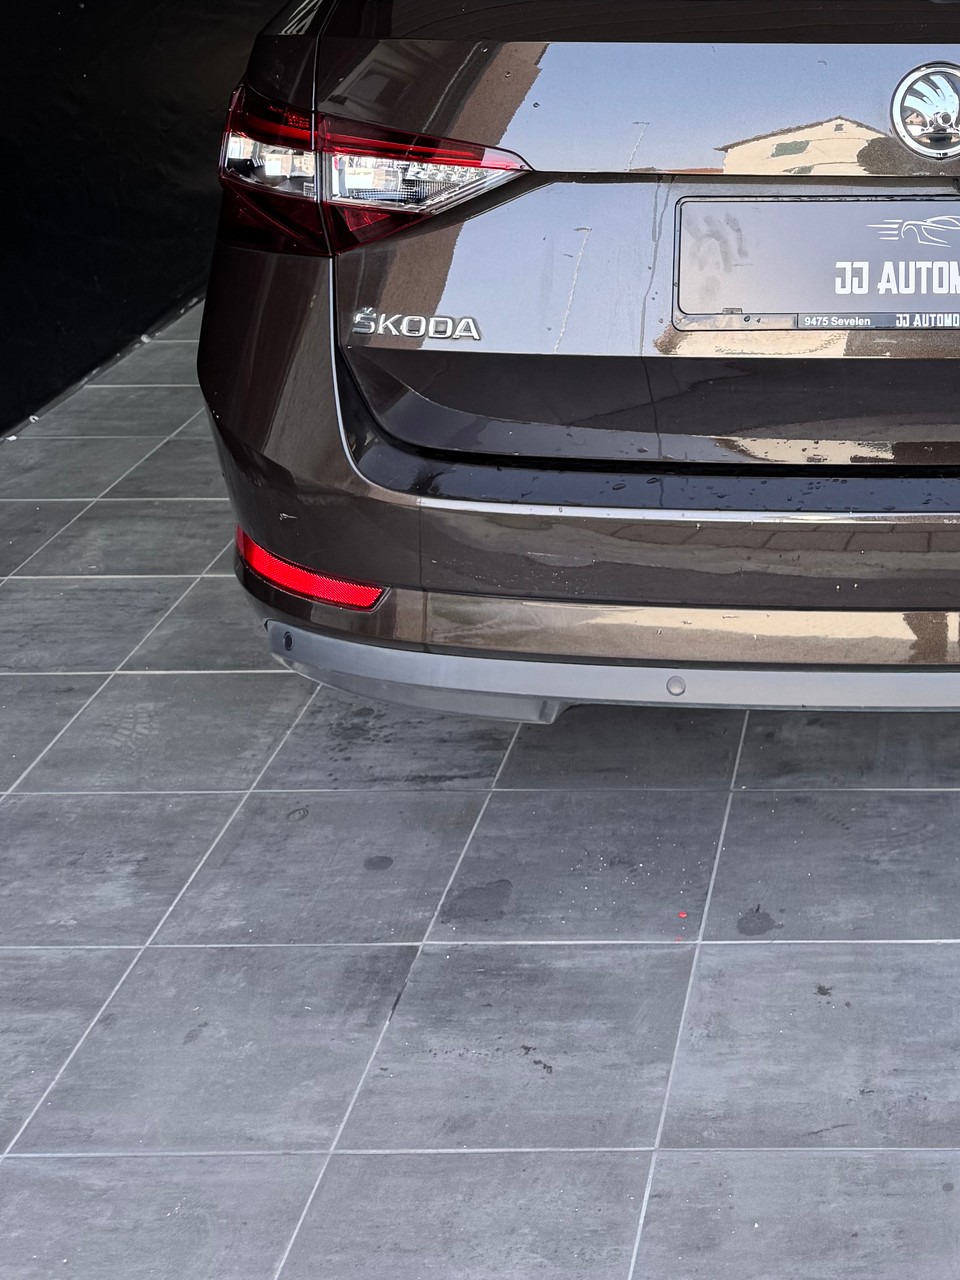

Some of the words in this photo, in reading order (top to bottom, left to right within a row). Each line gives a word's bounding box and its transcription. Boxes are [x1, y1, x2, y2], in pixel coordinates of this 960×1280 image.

[835, 261, 869, 295] JJ
[352, 307, 481, 340] ŠKODA
[804, 315, 829, 326] 9475
[830, 315, 871, 326] Sevelen
[895, 313, 910, 327] JJ
